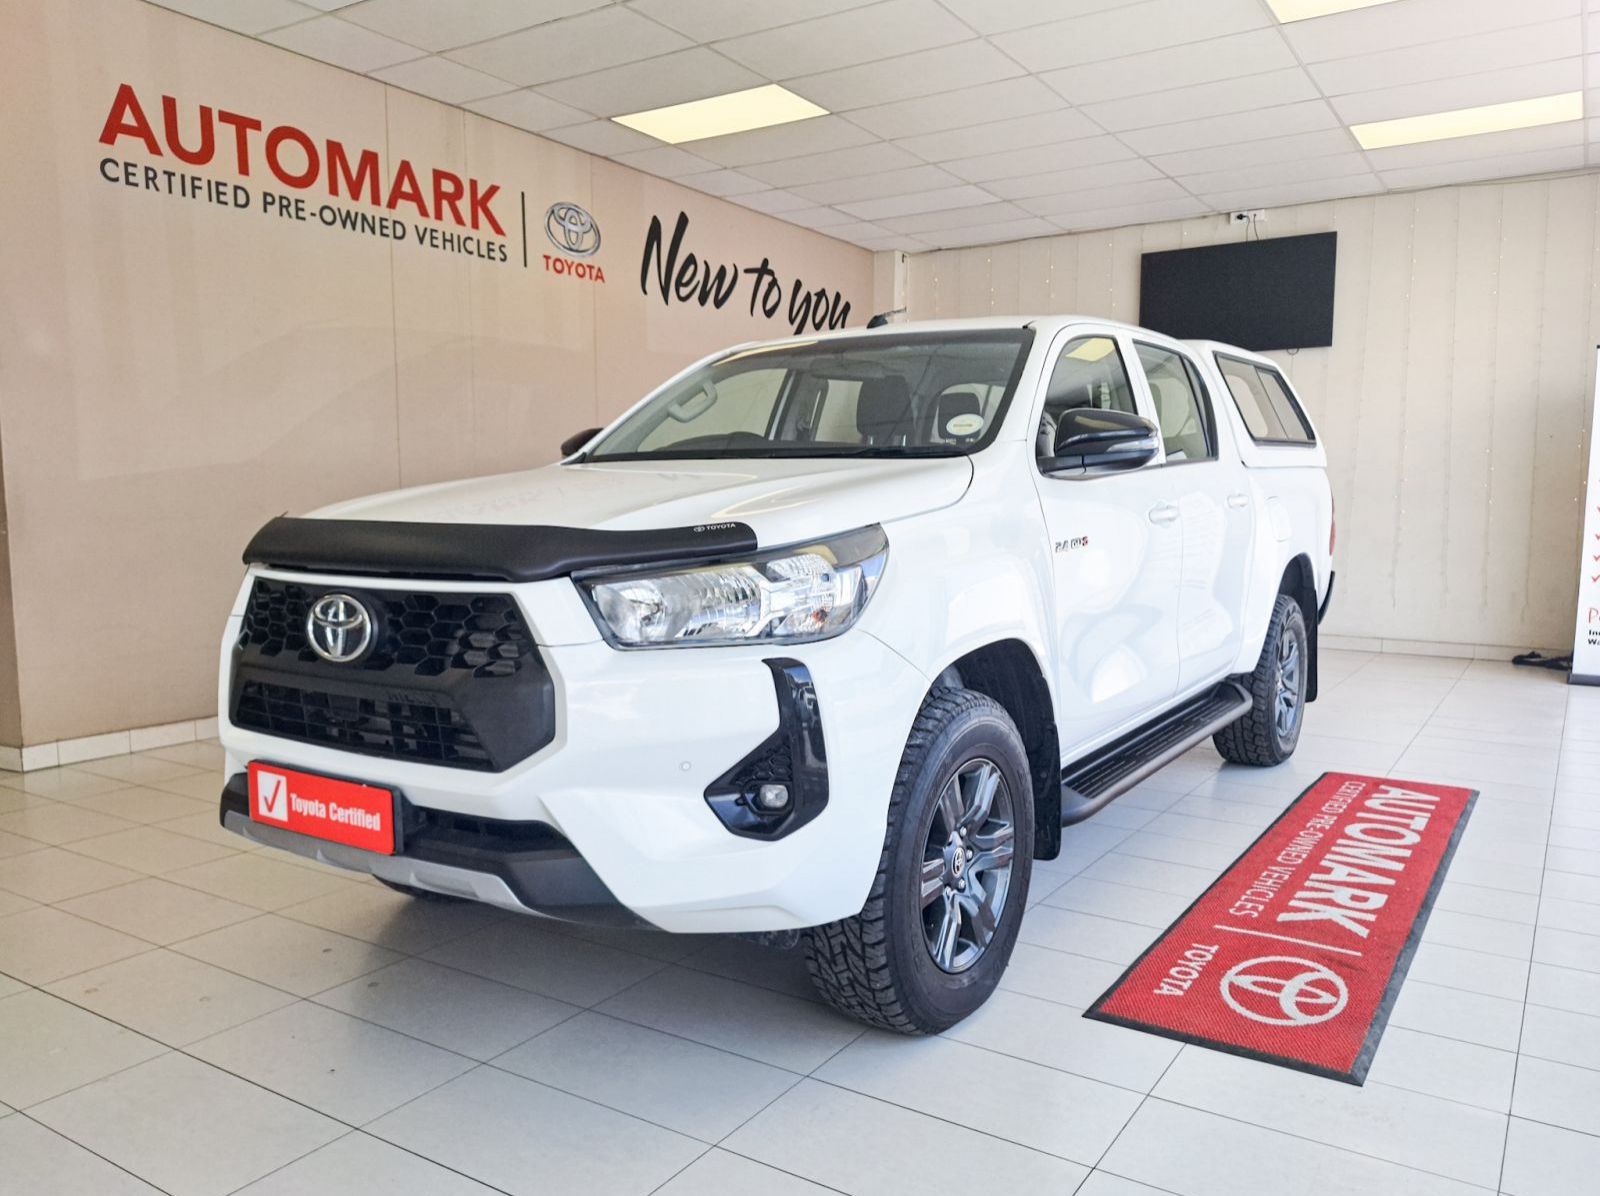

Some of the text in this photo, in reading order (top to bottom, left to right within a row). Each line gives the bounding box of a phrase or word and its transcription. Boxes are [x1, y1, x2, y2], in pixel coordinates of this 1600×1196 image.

[99, 83, 506, 237] AUTOMARK
[100, 157, 508, 262] CERTIFIED PRE-OWNED VEHICLES
[542, 254, 606, 284] TOYOTA
[640, 211, 851, 335] New to you
[706, 523, 736, 531] TOYOTA
[290, 793, 381, 832] Toyota Certified
[1228, 780, 1366, 919] CERTIFIED PRE-OWNED VEHICLES
[1276, 784, 1441, 938] AUTOMARK
[1152, 942, 1220, 997] TOYOTA
